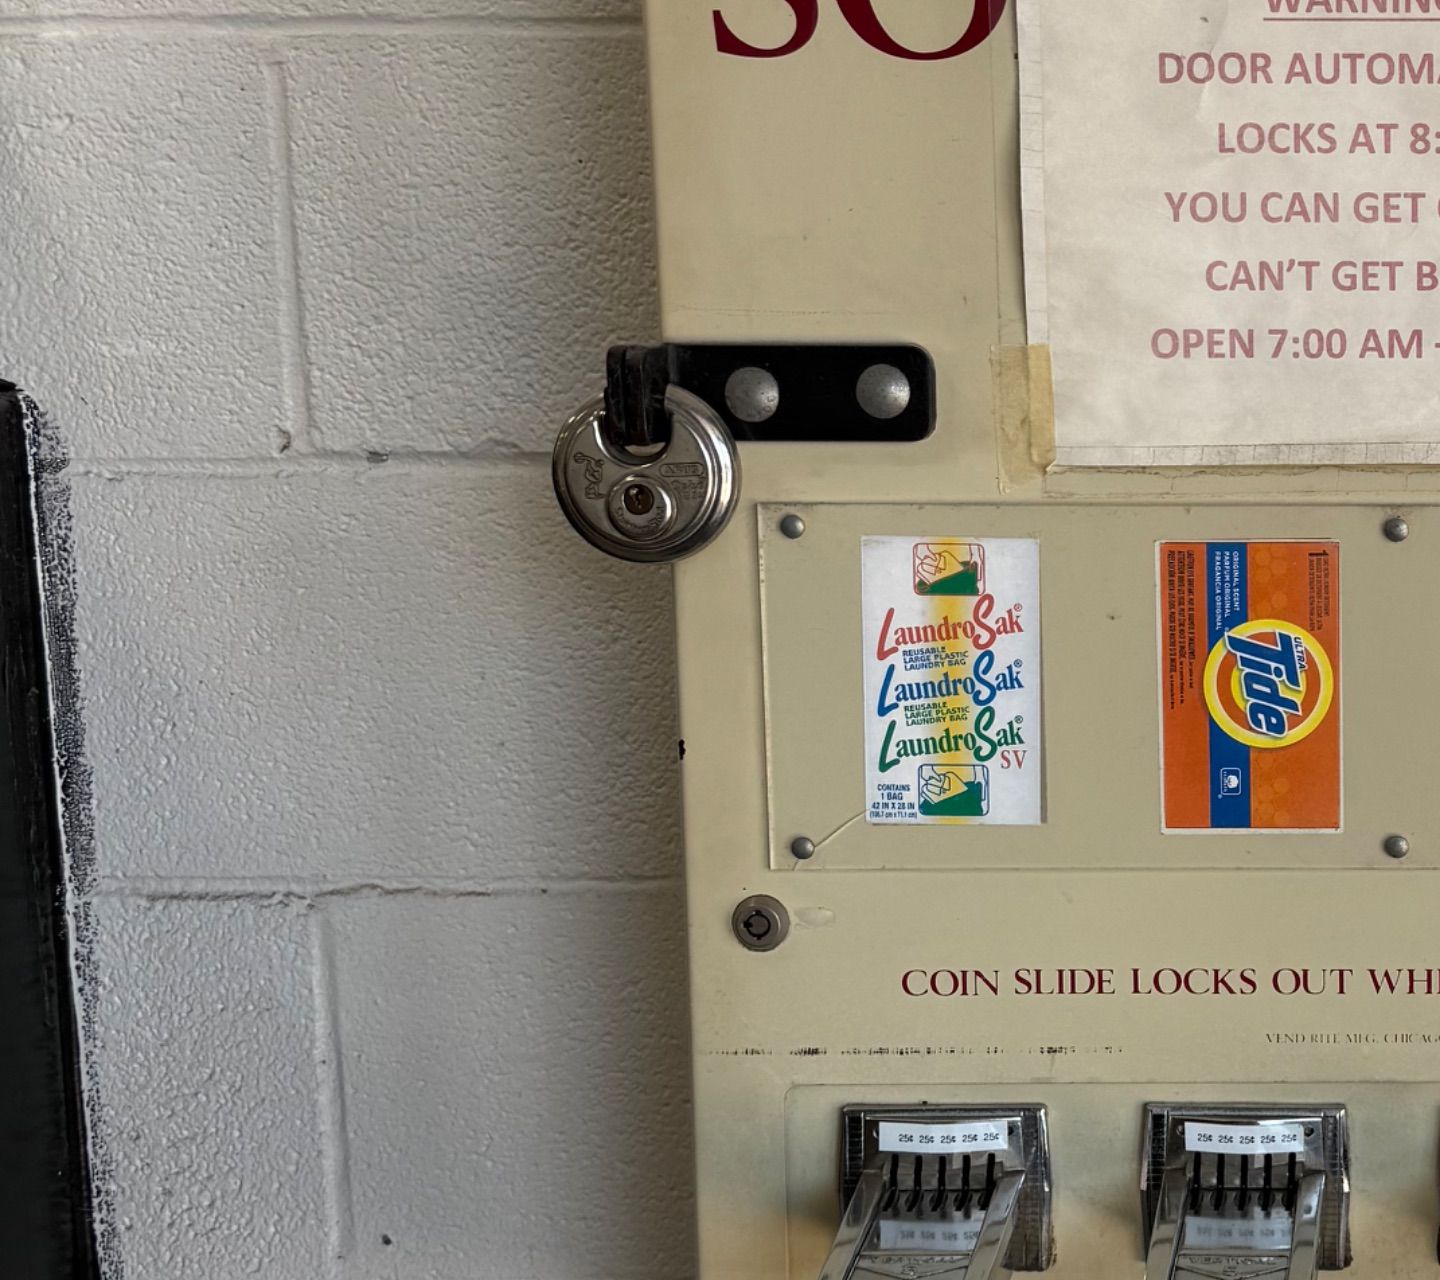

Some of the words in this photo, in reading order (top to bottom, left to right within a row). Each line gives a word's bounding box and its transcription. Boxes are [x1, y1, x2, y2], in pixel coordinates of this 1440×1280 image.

[1159, 51, 1273, 84] DOOR
[1218, 122, 1337, 154] LOCKS
[1349, 123, 1399, 154] AT
[1164, 192, 1247, 223] YOU
[1261, 192, 1339, 223] CAN
[1354, 192, 1426, 223] GET
[1332, 261, 1404, 291] GET
[1151, 328, 1254, 359] OPEN
[1268, 328, 1346, 359] 7:00
[1359, 329, 1422, 358] AM
[902, 647, 946, 657] REUSABLE
[903, 655, 932, 664] LARGE
[934, 651, 968, 661] PLASTIC
[1294, 637, 1307, 672] ULTRA
[904, 661, 946, 671] LAUNDRY
[948, 659, 966, 667] BAG
[1225, 631, 1302, 737] Tide
[905, 702, 947, 712] REUSABLE
[905, 710, 932, 719] LARGE
[935, 706, 969, 716] PLASTIC
[906, 716, 947, 726] LAUNDRY
[1000, 750, 1028, 769] SV
[887, 792, 903, 800] BAG
[902, 970, 999, 996] COIN
[1015, 969, 1115, 994] SLIDE
[1132, 968, 1257, 994] LOCKS
[1272, 968, 1353, 994] OUT
